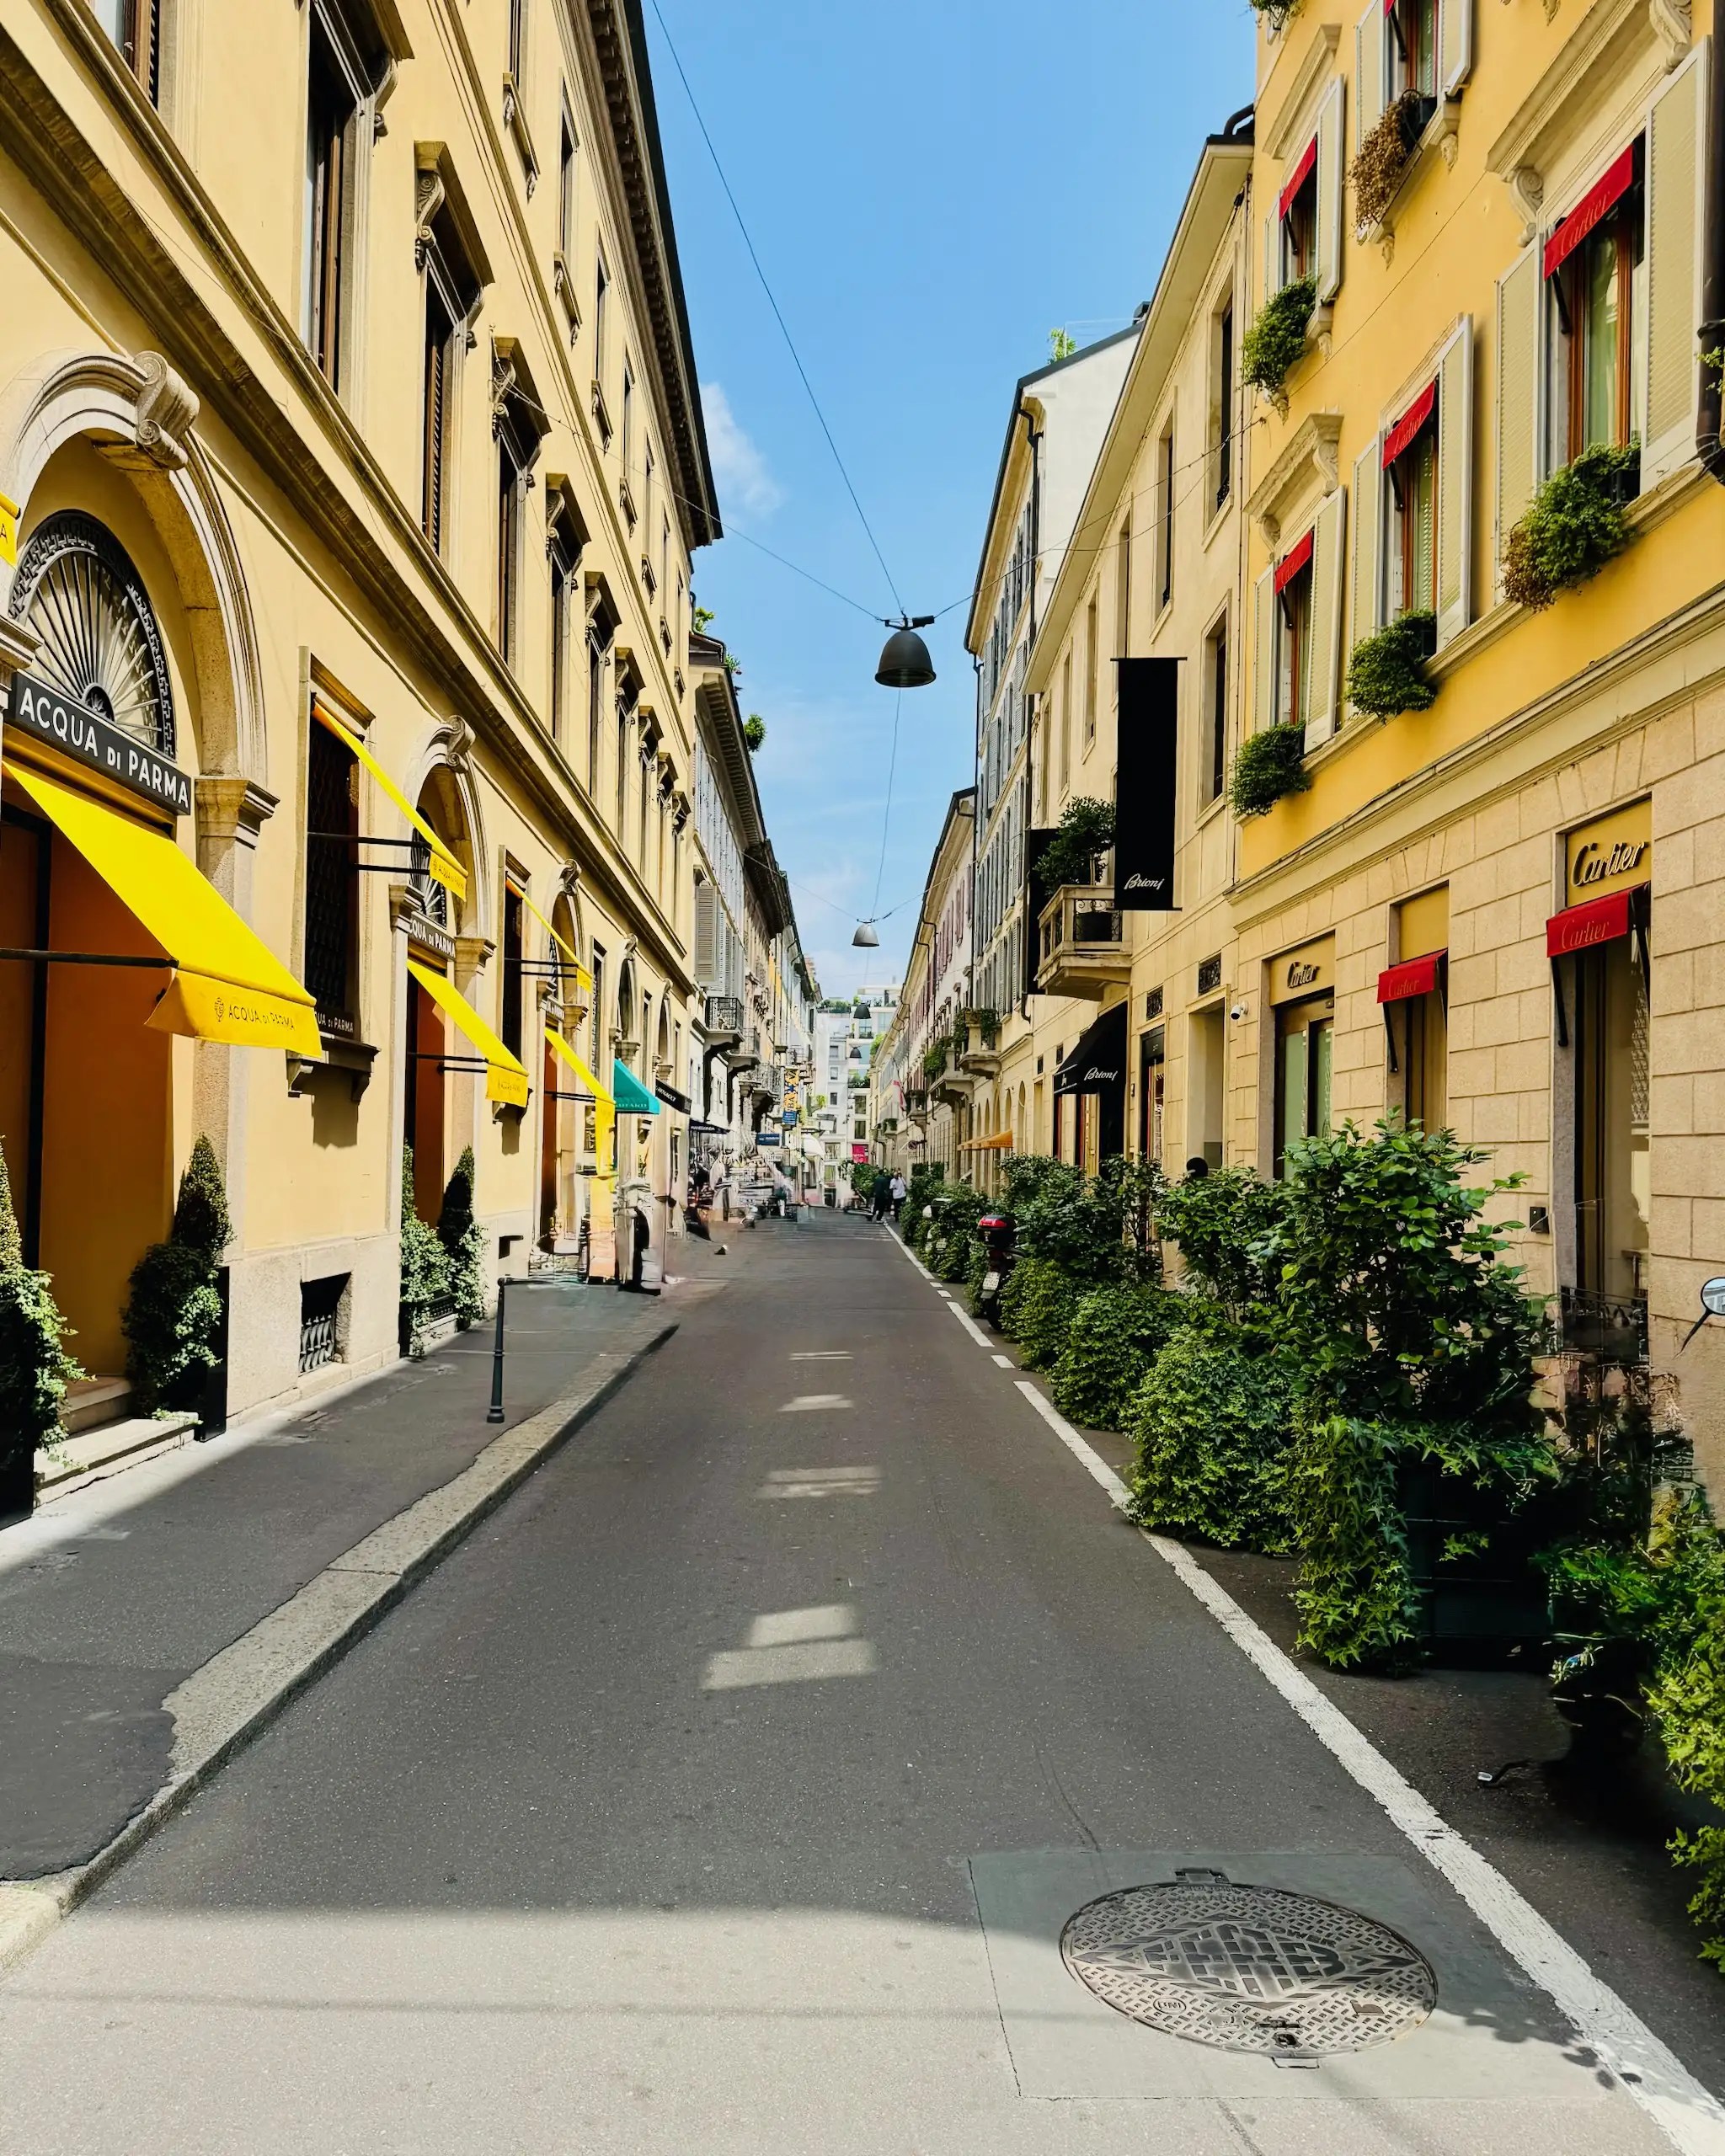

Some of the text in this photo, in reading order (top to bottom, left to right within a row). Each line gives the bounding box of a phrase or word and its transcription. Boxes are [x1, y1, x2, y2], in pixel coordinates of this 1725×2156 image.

[19, 687, 189, 808] ACQUA DI PARMA
[1572, 841, 1650, 888] Cartier
[1124, 873, 1166, 890] Brioni
[435, 932, 456, 958] PARMA
[1561, 919, 1610, 949] Cartier
[1287, 961, 1321, 989] Cartier
[1388, 978, 1420, 997] Cartier
[228, 1004, 261, 1024] ACQUA
[334, 1017, 354, 1033] PARMA
[1083, 1067, 1118, 1081] Brioni
[1255, 1921, 1338, 1949] POWER
